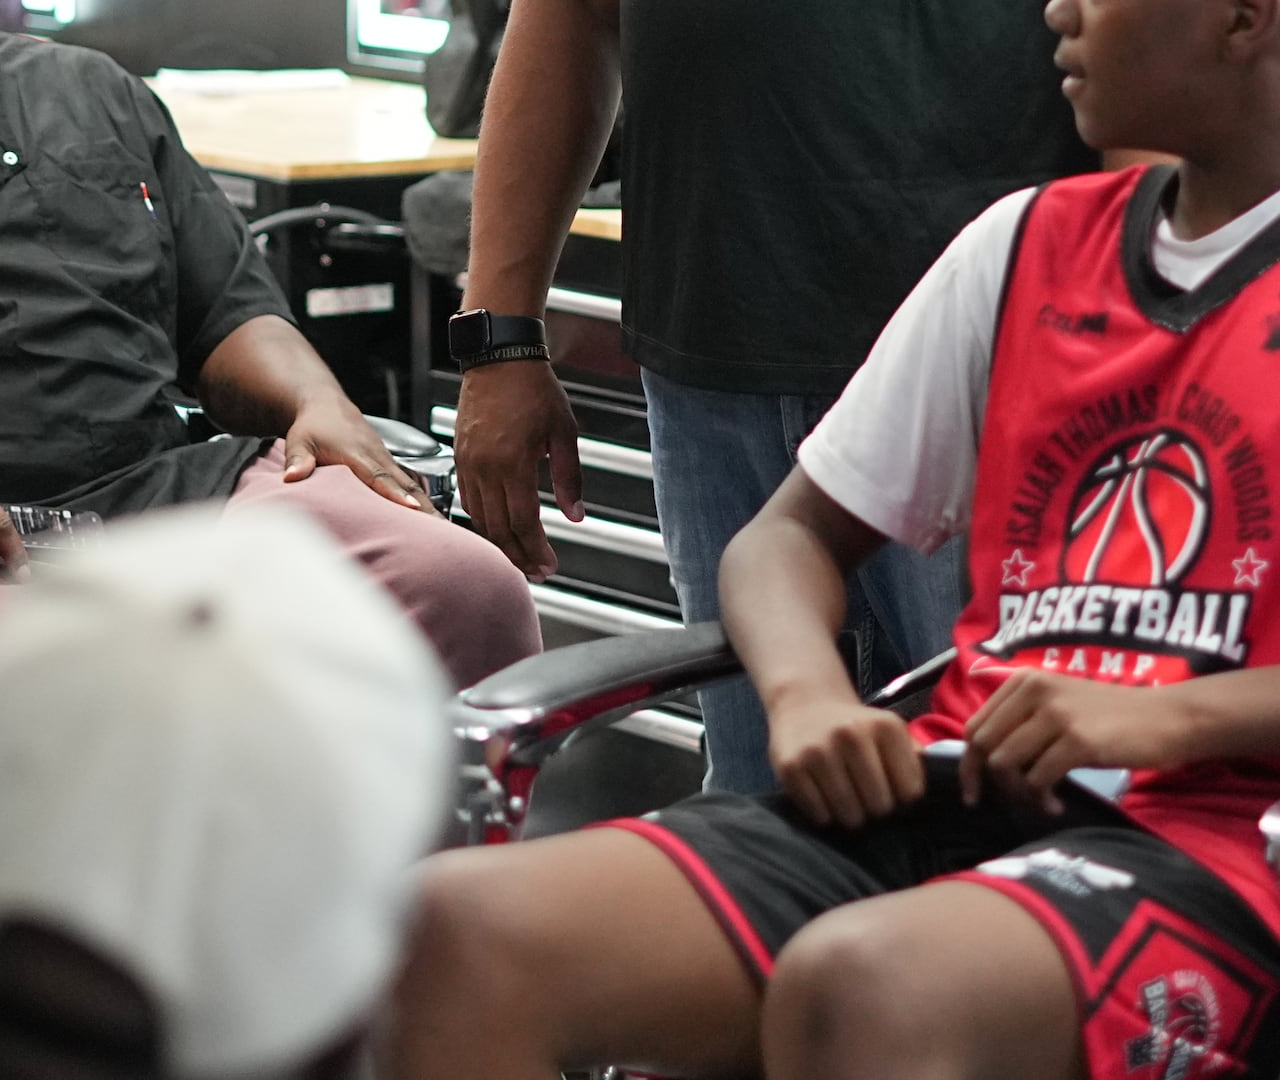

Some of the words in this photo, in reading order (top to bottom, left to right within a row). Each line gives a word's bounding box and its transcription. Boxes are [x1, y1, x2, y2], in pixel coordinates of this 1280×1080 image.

[1007, 450, 1064, 547] ISAIAH
[1050, 384, 1158, 461] THOMAS
[1225, 434, 1273, 542] WOODS
[982, 584, 1246, 663] BASKETBALL
[1041, 647, 1155, 678] CAMP
